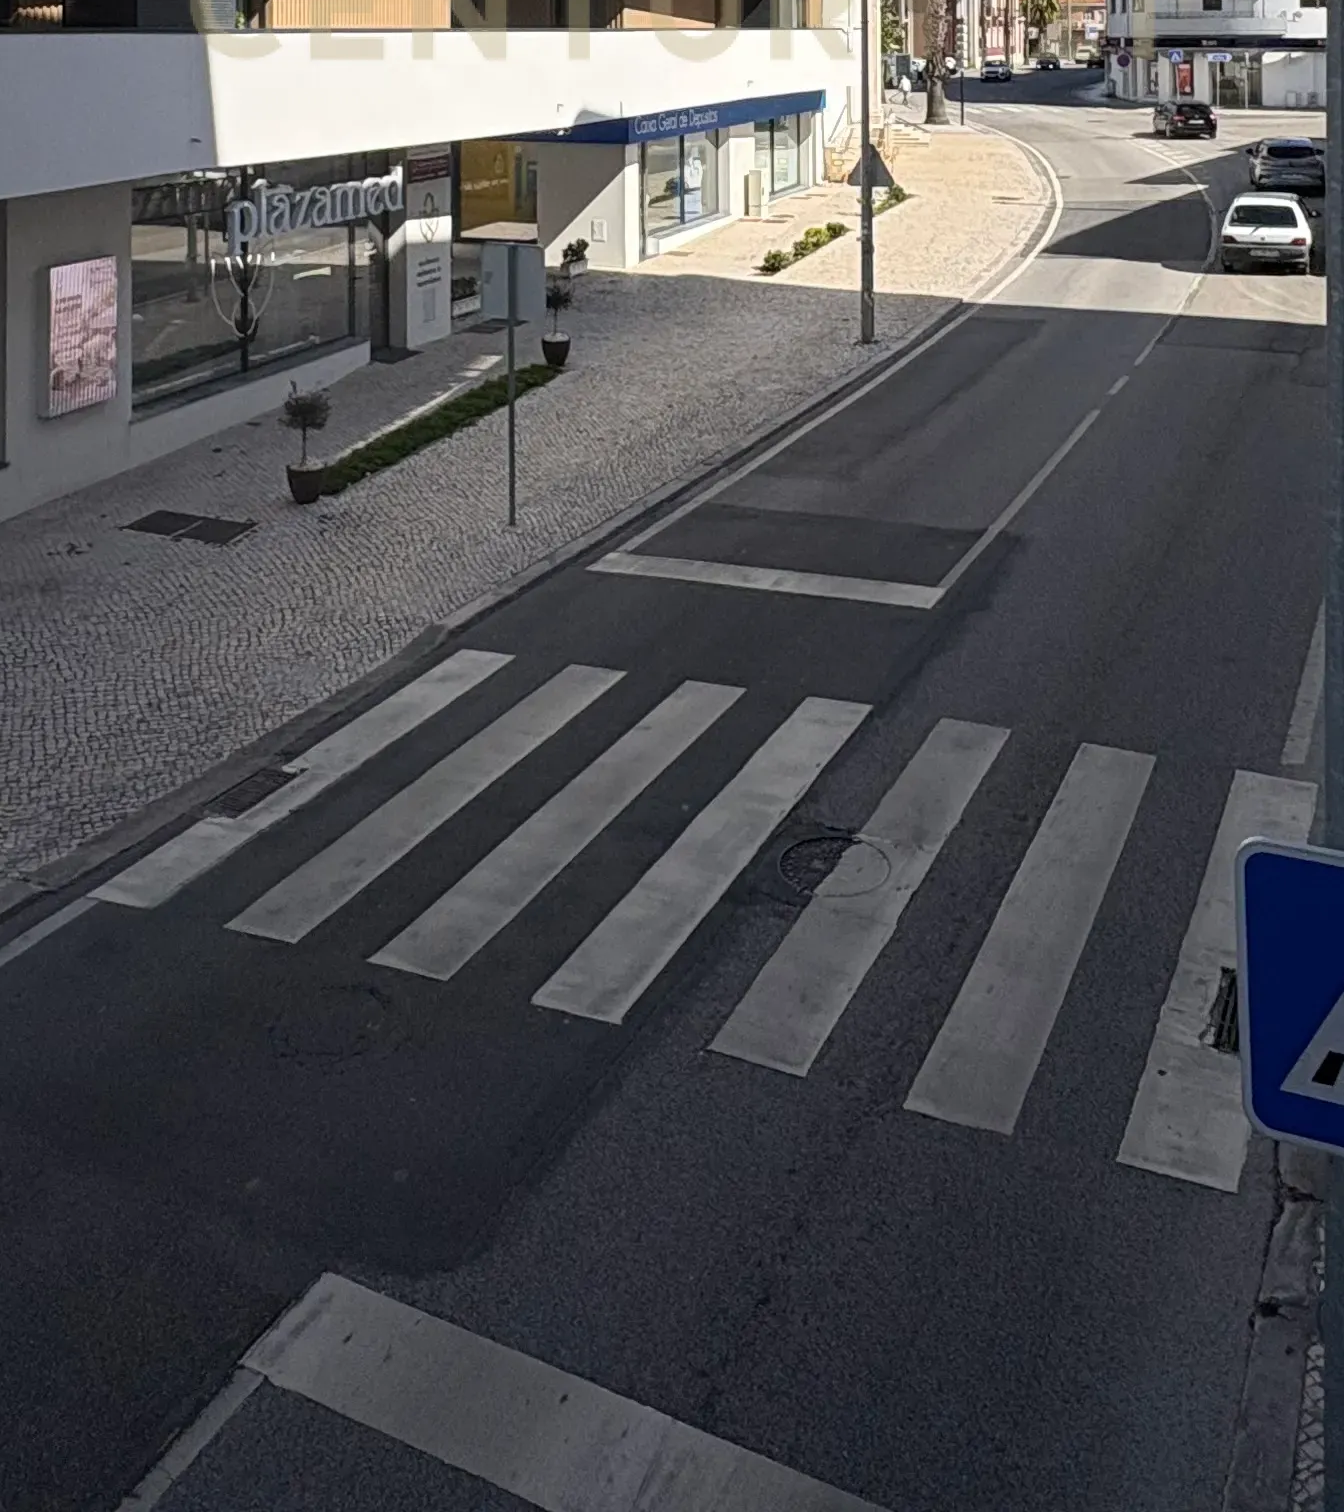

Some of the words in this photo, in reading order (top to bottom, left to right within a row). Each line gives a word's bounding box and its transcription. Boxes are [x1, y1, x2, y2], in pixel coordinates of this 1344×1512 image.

[634, 116, 657, 135] Caixa
[658, 113, 677, 131] Geral
[224, 163, 404, 256] plazamed
